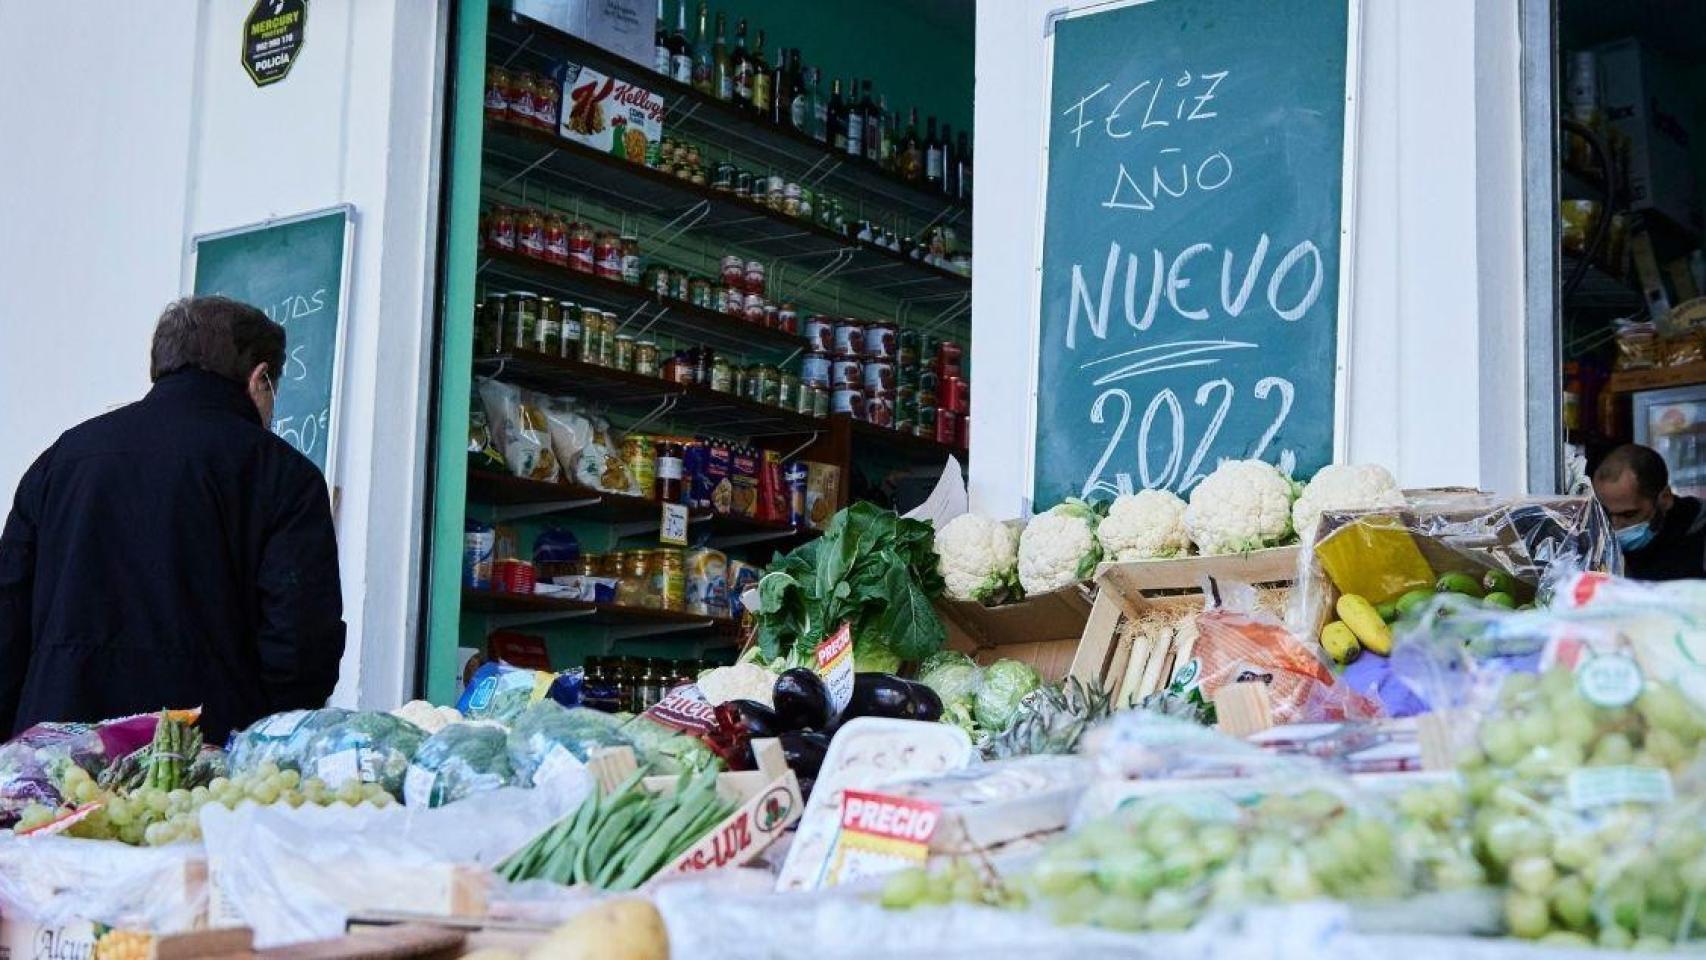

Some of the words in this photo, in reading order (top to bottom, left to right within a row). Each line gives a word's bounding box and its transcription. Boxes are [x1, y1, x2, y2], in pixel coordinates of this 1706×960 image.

[251, 11, 299, 35] MERCURY
[255, 52, 290, 72] POLICÍA
[1102, 147, 1232, 210] AÑO
[1066, 233, 1324, 349] NUEVO
[1080, 376, 1297, 500] 2022
[818, 627, 850, 667] PRECIO
[844, 798, 937, 842] PRECIO
